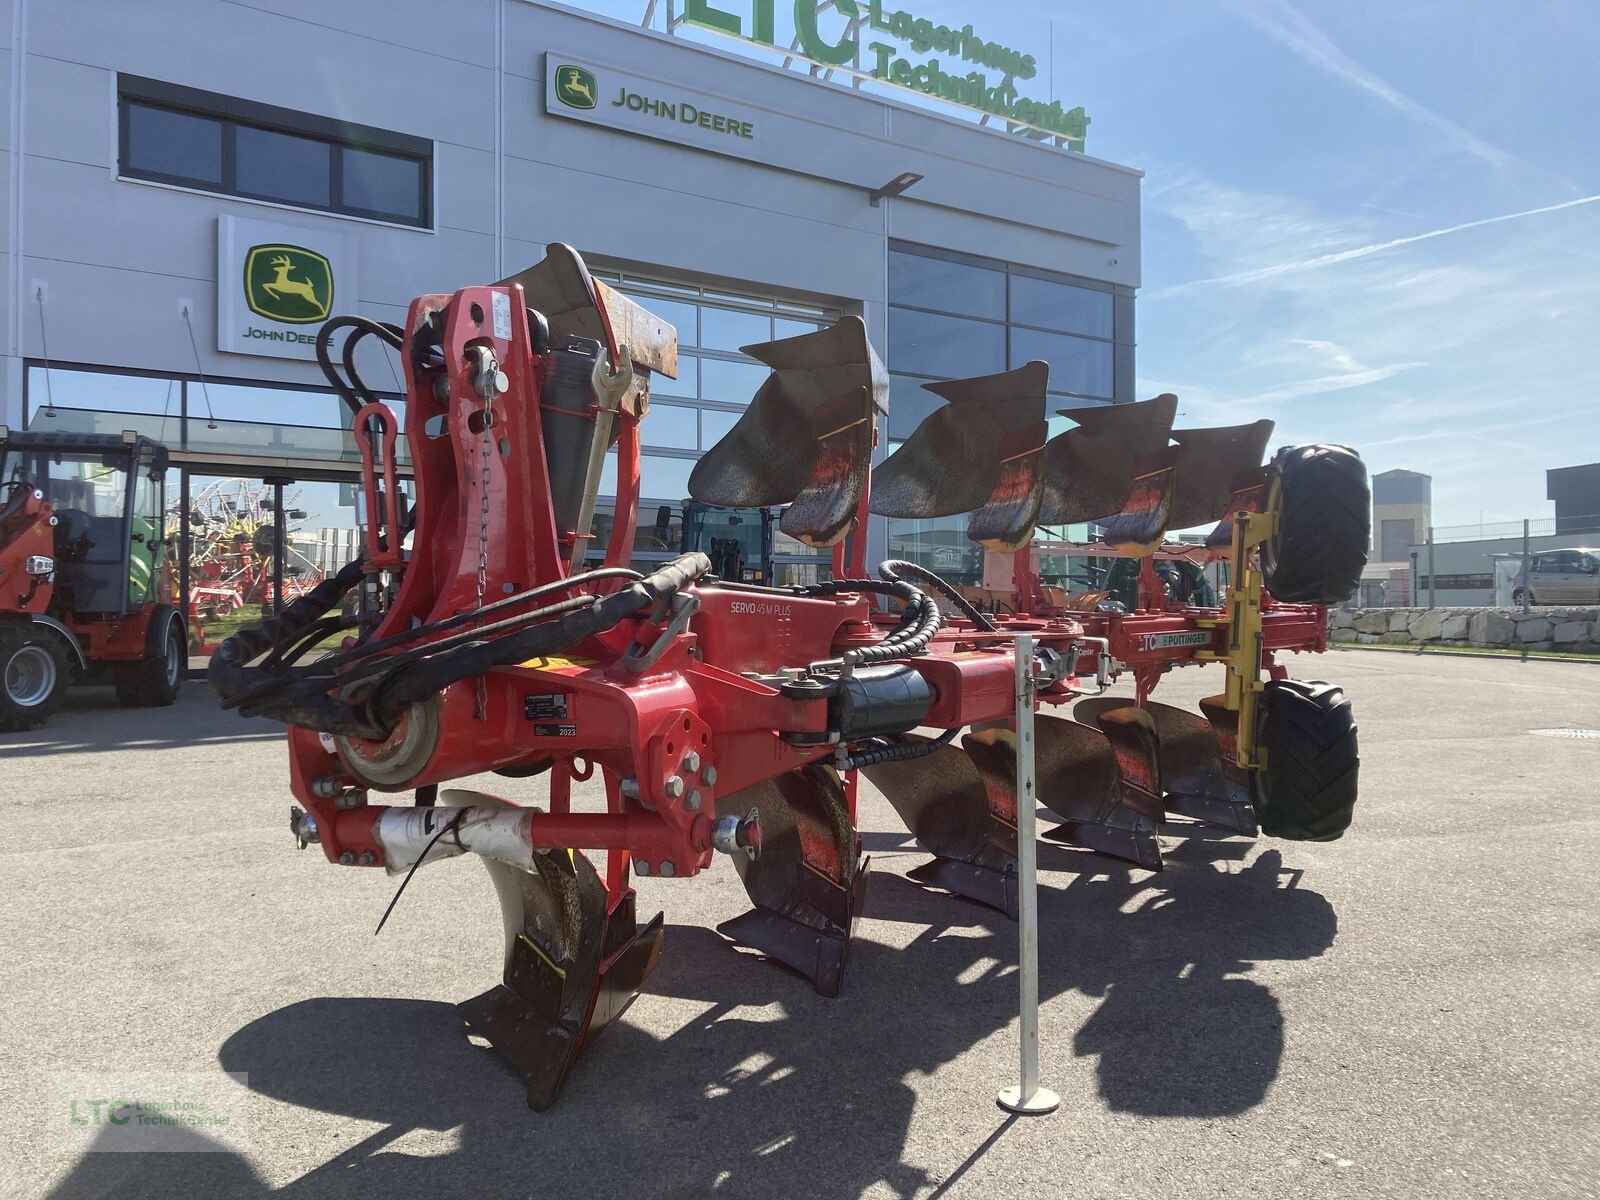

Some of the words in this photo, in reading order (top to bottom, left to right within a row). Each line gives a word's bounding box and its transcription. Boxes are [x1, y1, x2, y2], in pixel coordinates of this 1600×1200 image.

[869, 0, 1037, 80] Lagerhaus
[611, 87, 676, 121] JOHN
[679, 102, 754, 139] DEERE
[242, 326, 285, 342] JOHN
[286, 331, 335, 347] DEEE
[730, 602, 756, 614] SERVO
[774, 604, 792, 616] PLUS
[559, 728, 576, 736] 2023
